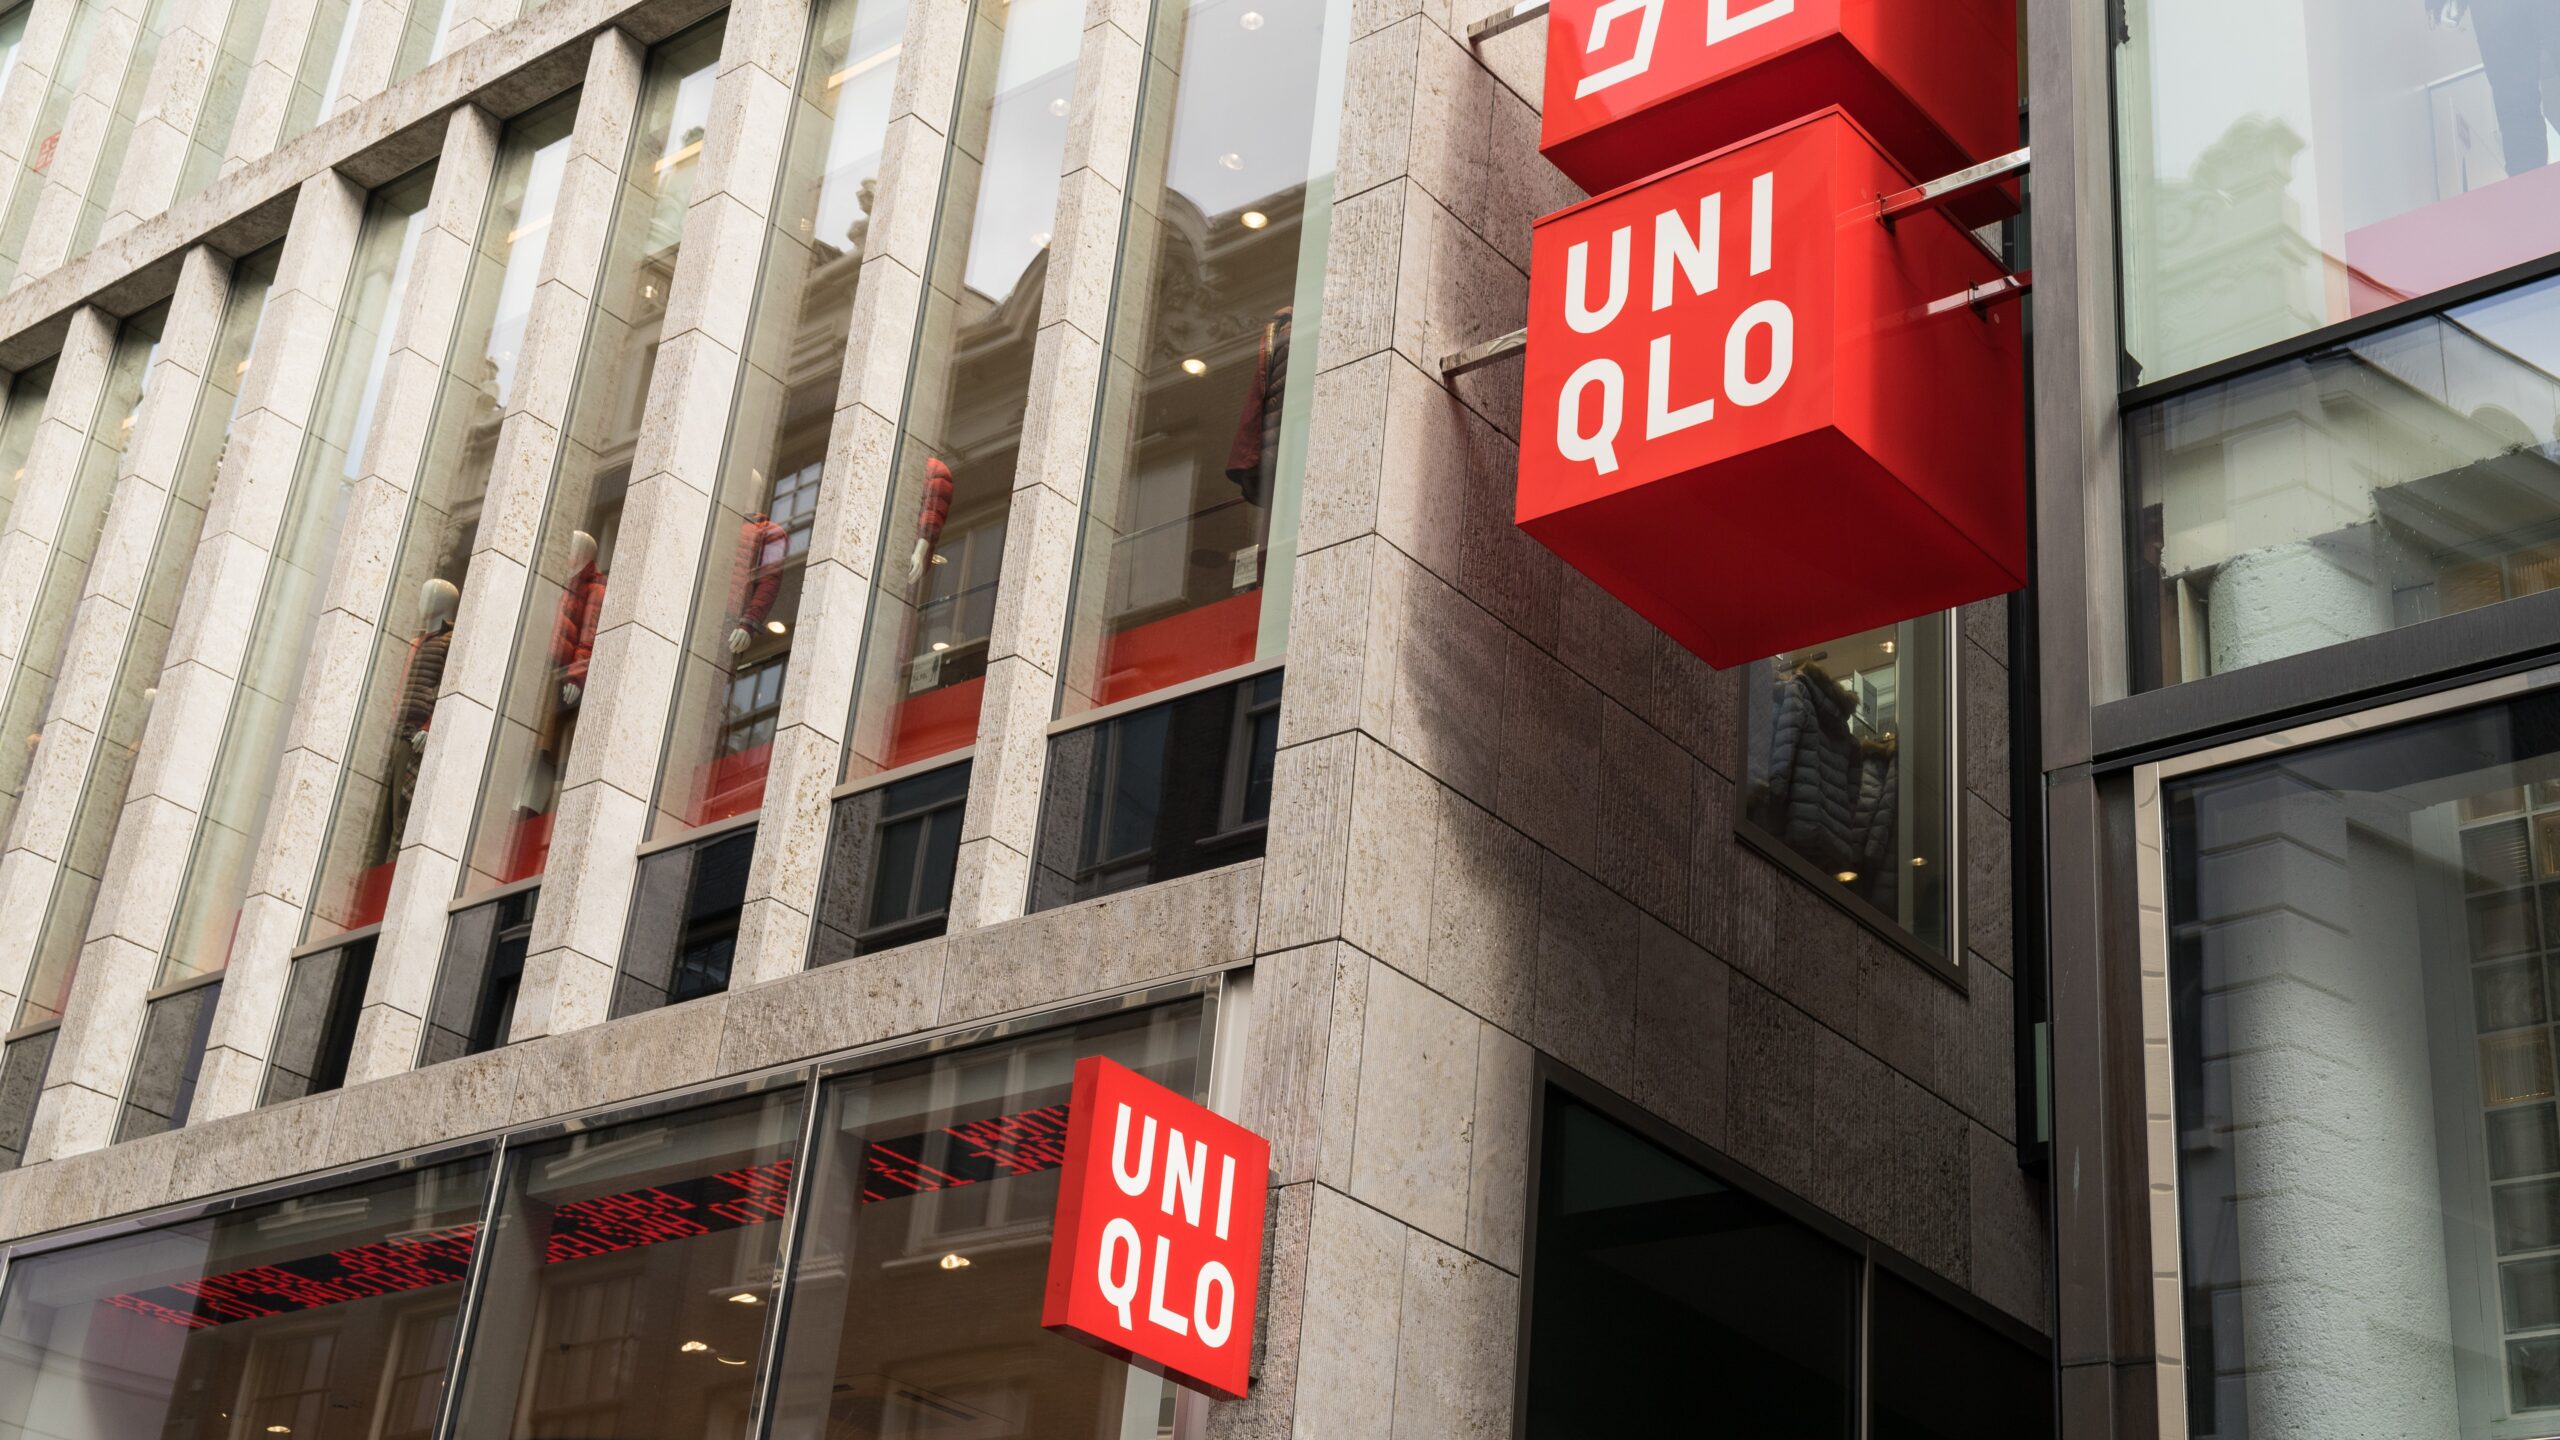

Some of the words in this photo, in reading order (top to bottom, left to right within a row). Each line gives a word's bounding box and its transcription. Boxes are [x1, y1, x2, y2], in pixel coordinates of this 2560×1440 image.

[1565, 172, 1773, 334] UNI
[1556, 299, 1794, 475] QLO
[1111, 1102, 1236, 1241] UNI
[1097, 1217, 1235, 1348] QLO
